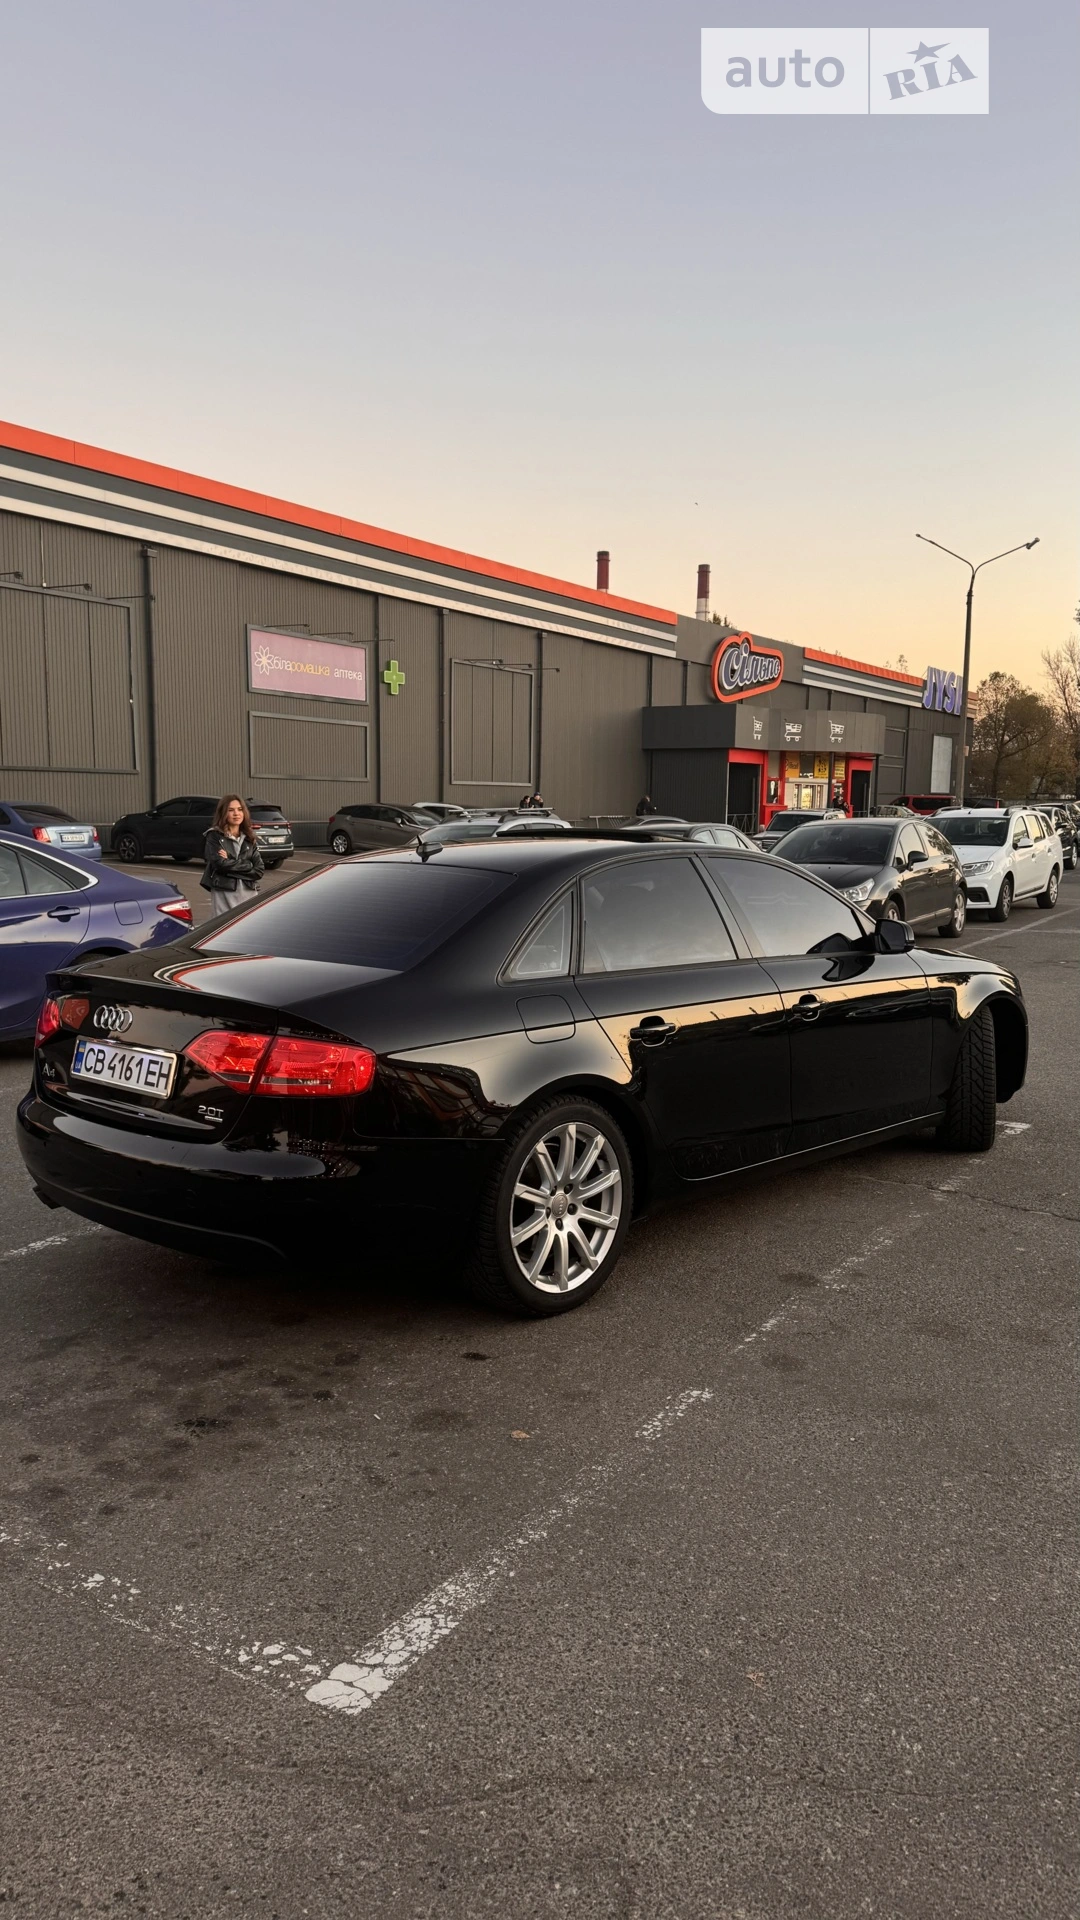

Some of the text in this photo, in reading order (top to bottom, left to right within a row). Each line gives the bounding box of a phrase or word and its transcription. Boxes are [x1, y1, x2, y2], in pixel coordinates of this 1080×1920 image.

[333, 667, 363, 681] аптека
[720, 642, 780, 690] Сільпо
[42, 1063, 56, 1078] A4
[84, 1047, 106, 1075] CB
[108, 1052, 144, 1084] 4161
[144, 1059, 172, 1090] EH
